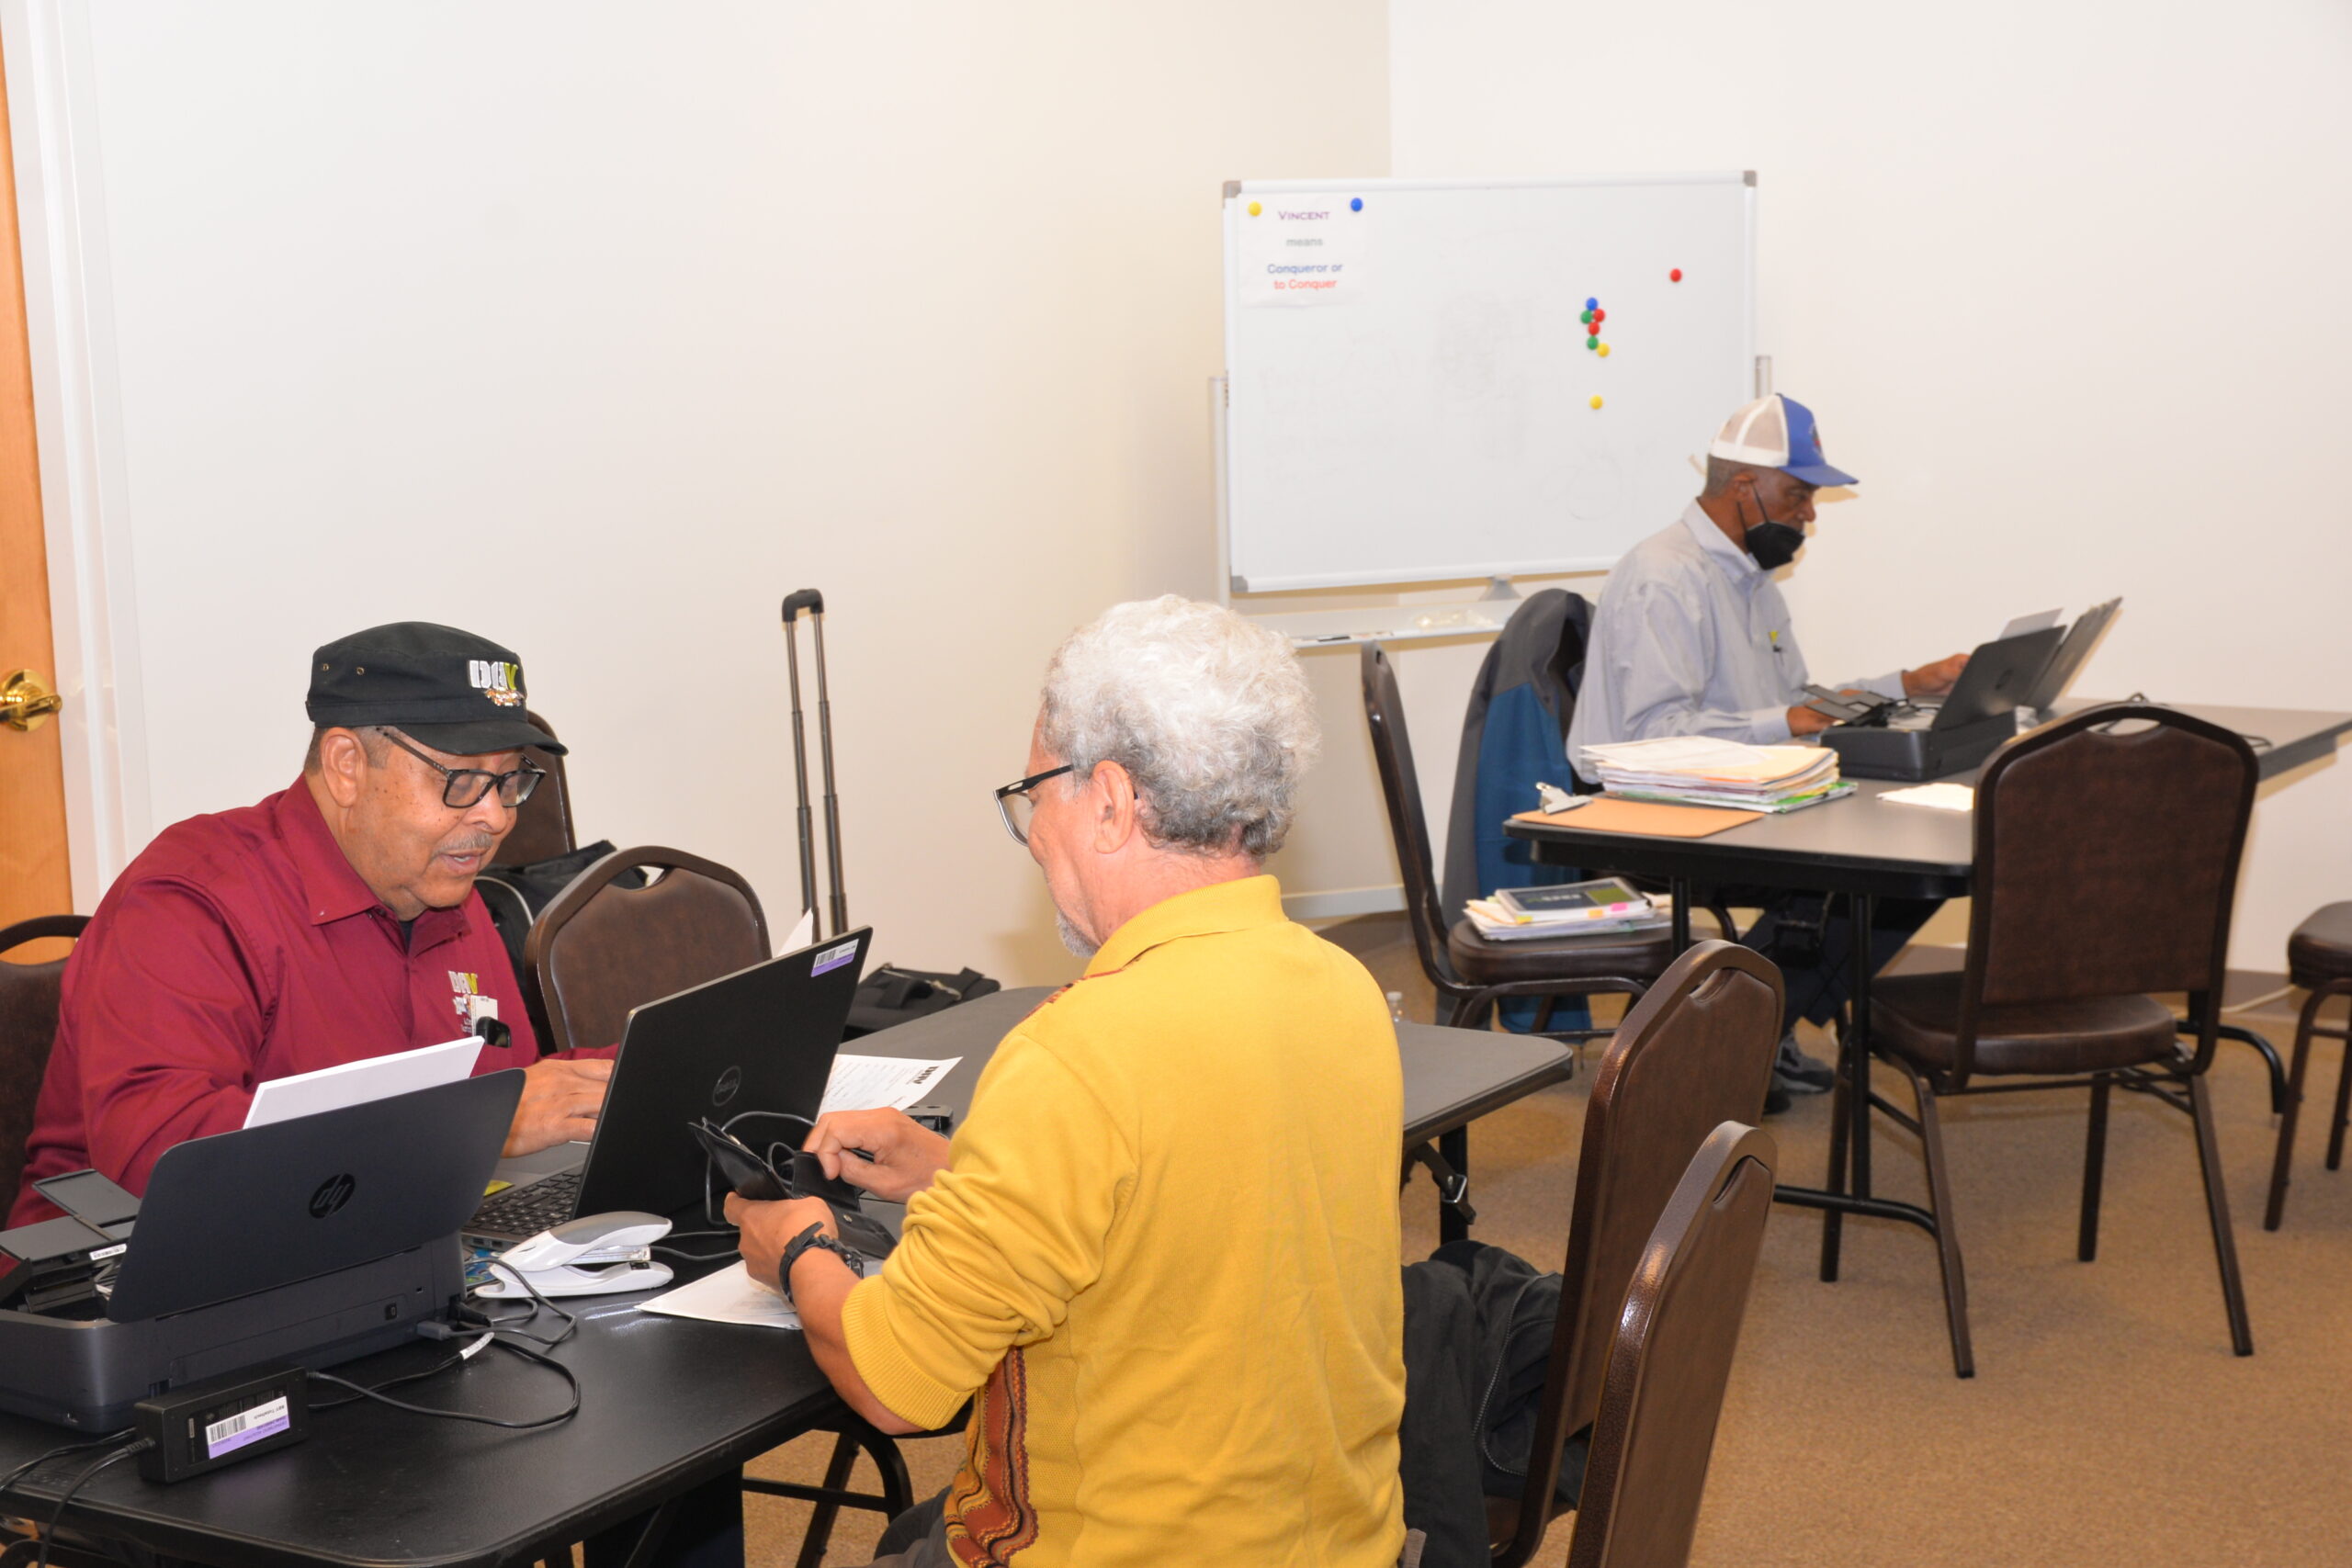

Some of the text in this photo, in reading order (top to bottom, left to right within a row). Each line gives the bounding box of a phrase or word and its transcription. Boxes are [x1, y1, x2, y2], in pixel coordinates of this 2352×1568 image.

[1267, 264, 1342, 275] Conqueror or
[1273, 278, 1338, 289] to Conquer
[447, 970, 478, 994] DAV
[312, 1174, 352, 1219] hp
